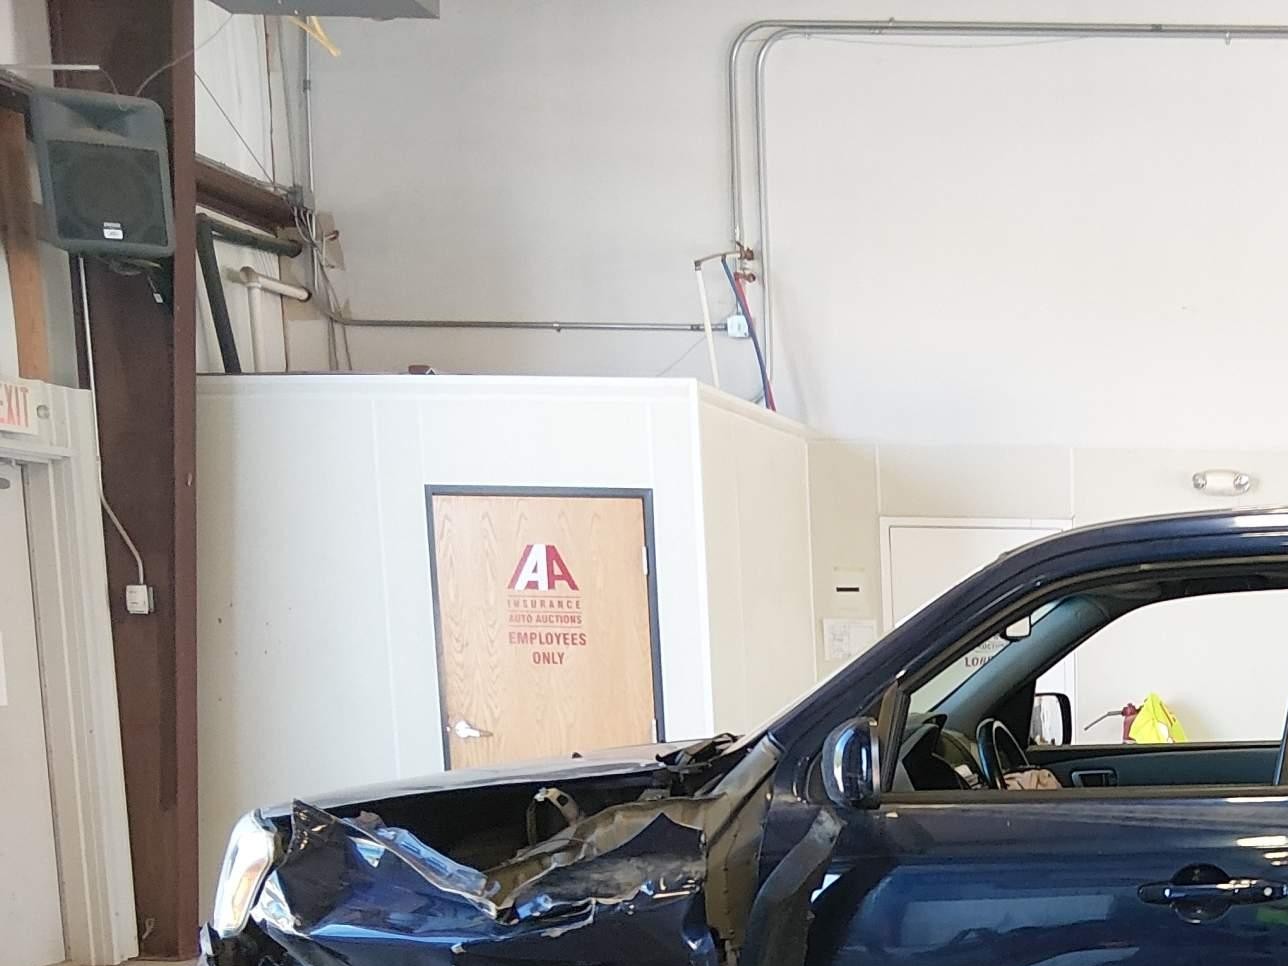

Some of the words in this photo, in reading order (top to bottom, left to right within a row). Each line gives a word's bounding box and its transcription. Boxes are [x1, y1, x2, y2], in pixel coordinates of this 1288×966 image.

[507, 599, 582, 610] INSURANCE
[508, 614, 533, 624] AUTO
[535, 615, 582, 625] AUCTIONS
[508, 631, 587, 646] EMPLOYEES
[532, 651, 565, 665] ONLY
